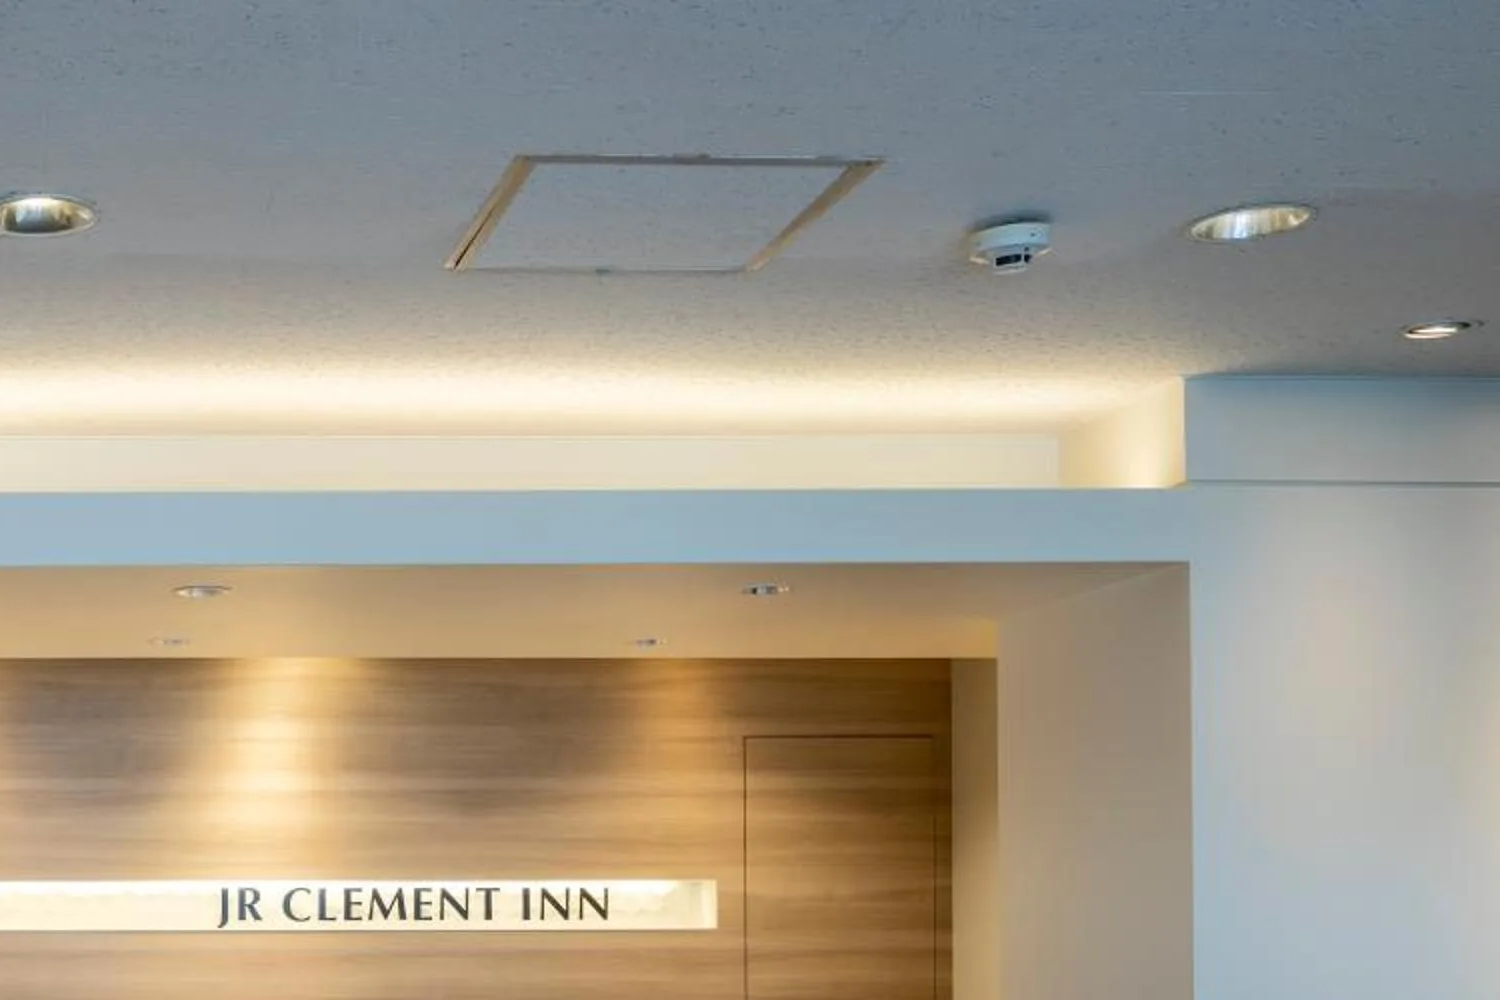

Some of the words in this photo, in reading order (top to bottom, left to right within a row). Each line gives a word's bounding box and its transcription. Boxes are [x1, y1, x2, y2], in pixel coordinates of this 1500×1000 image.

[217, 887, 262, 928] JR
[282, 887, 501, 922] CLEMENT
[521, 887, 609, 921] INN
